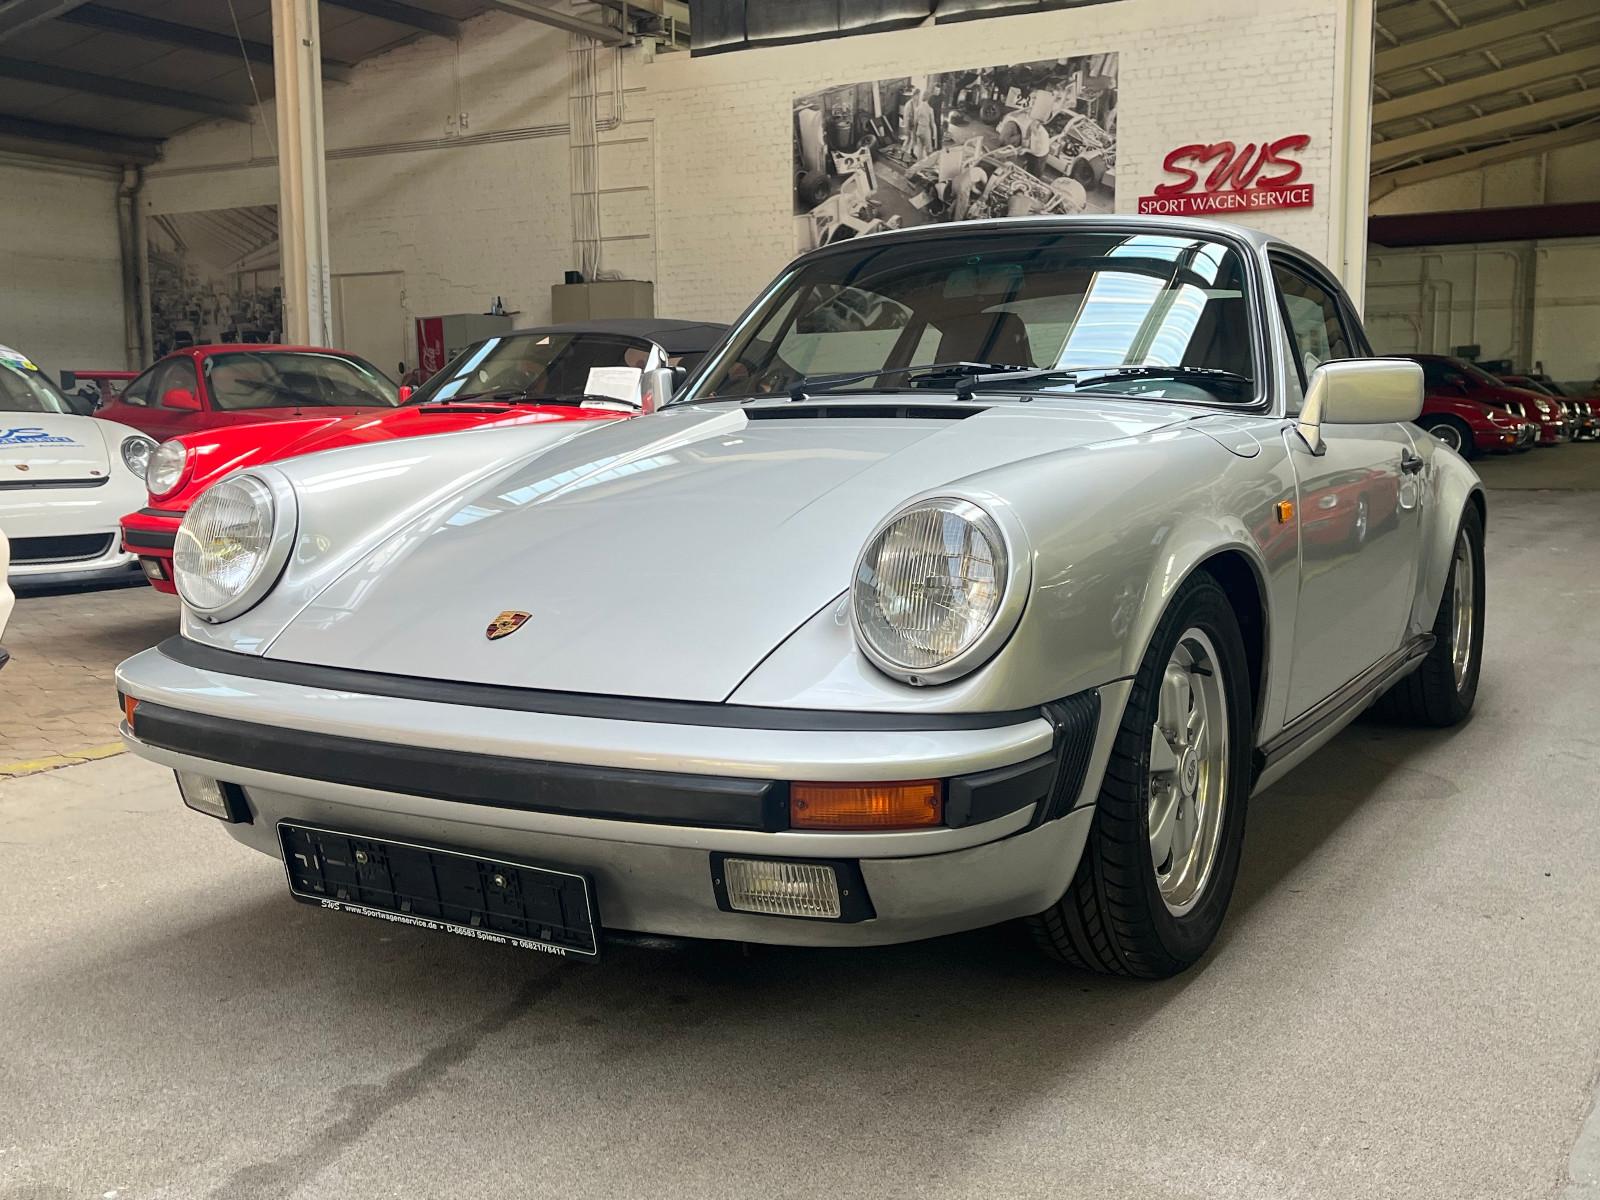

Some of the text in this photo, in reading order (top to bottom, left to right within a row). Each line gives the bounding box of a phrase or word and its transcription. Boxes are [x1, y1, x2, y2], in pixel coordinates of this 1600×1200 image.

[1154, 134, 1312, 196] SWS
[1140, 188, 1310, 215] SPORT WAGEN SERVICE
[344, 905, 438, 930] www.Sportwagenservice.de
[476, 932, 506, 944] Spiesen
